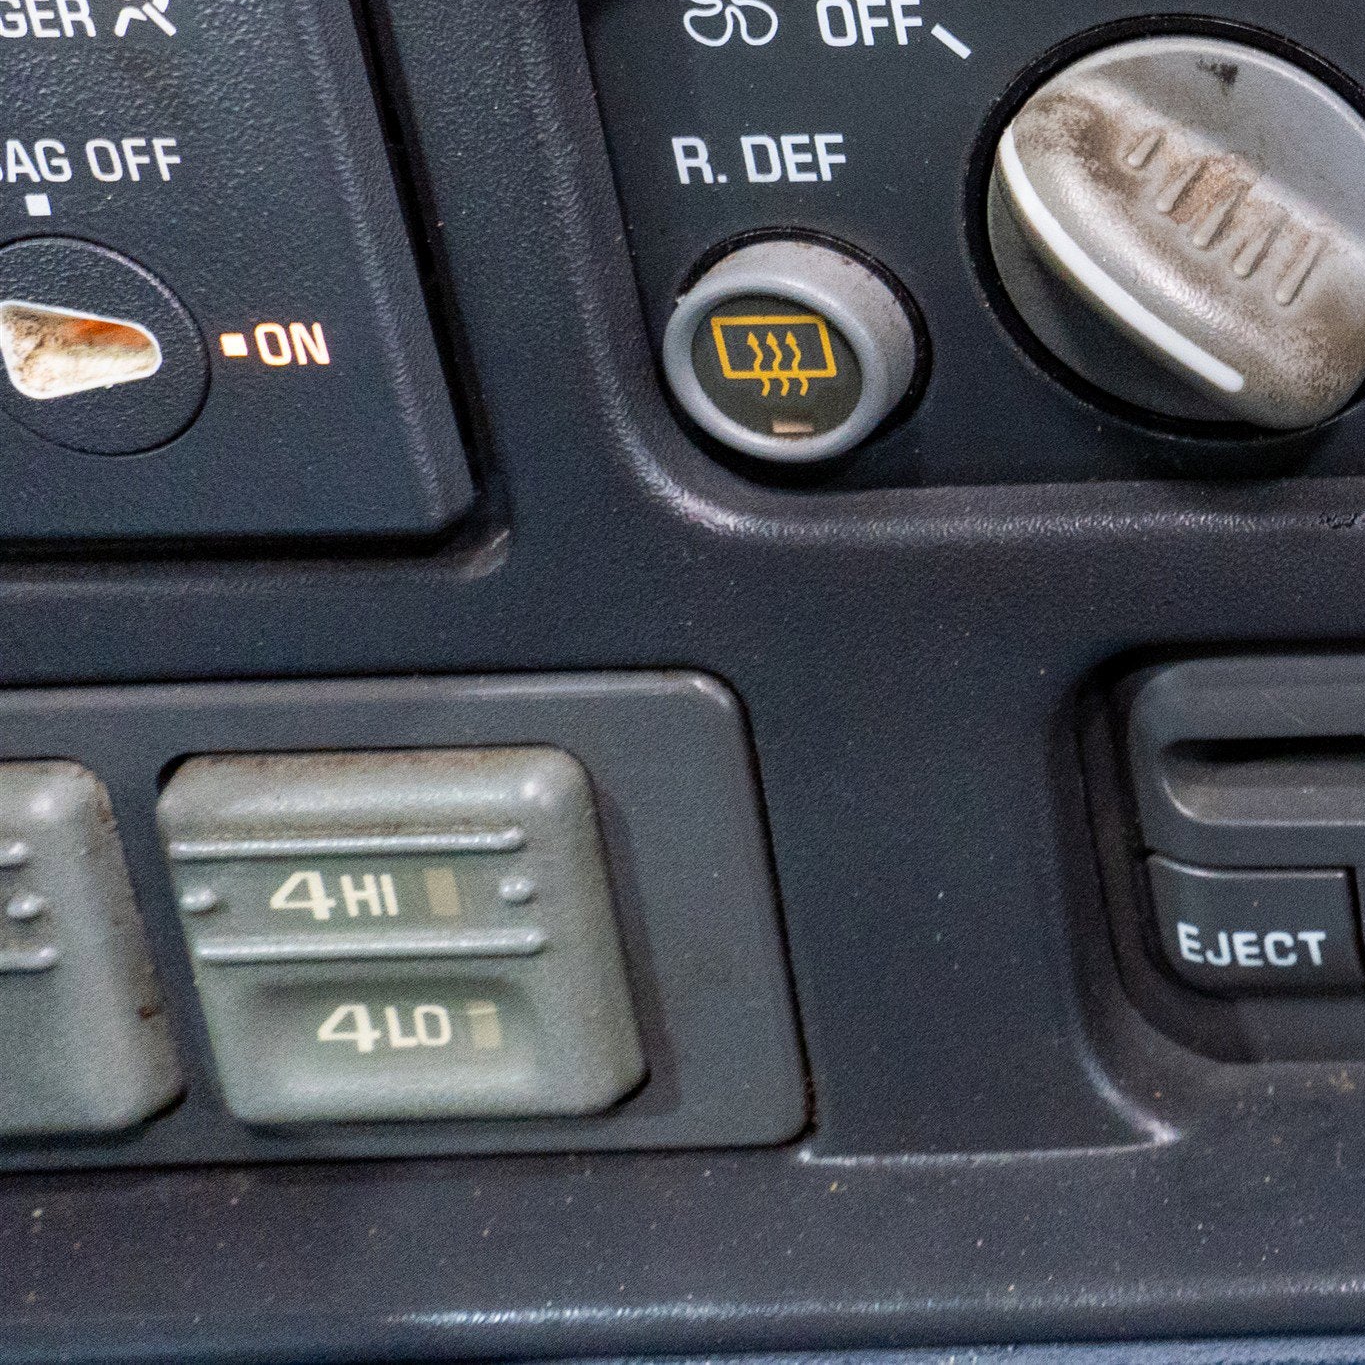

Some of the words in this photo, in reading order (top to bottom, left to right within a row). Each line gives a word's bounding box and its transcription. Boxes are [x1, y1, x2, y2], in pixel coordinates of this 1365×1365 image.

[0, 138, 73, 183] AG
[85, 138, 181, 182] OFF
[671, 136, 727, 185] R.
[740, 133, 847, 183] DEF
[254, 322, 331, 366] ON
[1177, 922, 1326, 966] EJECT
